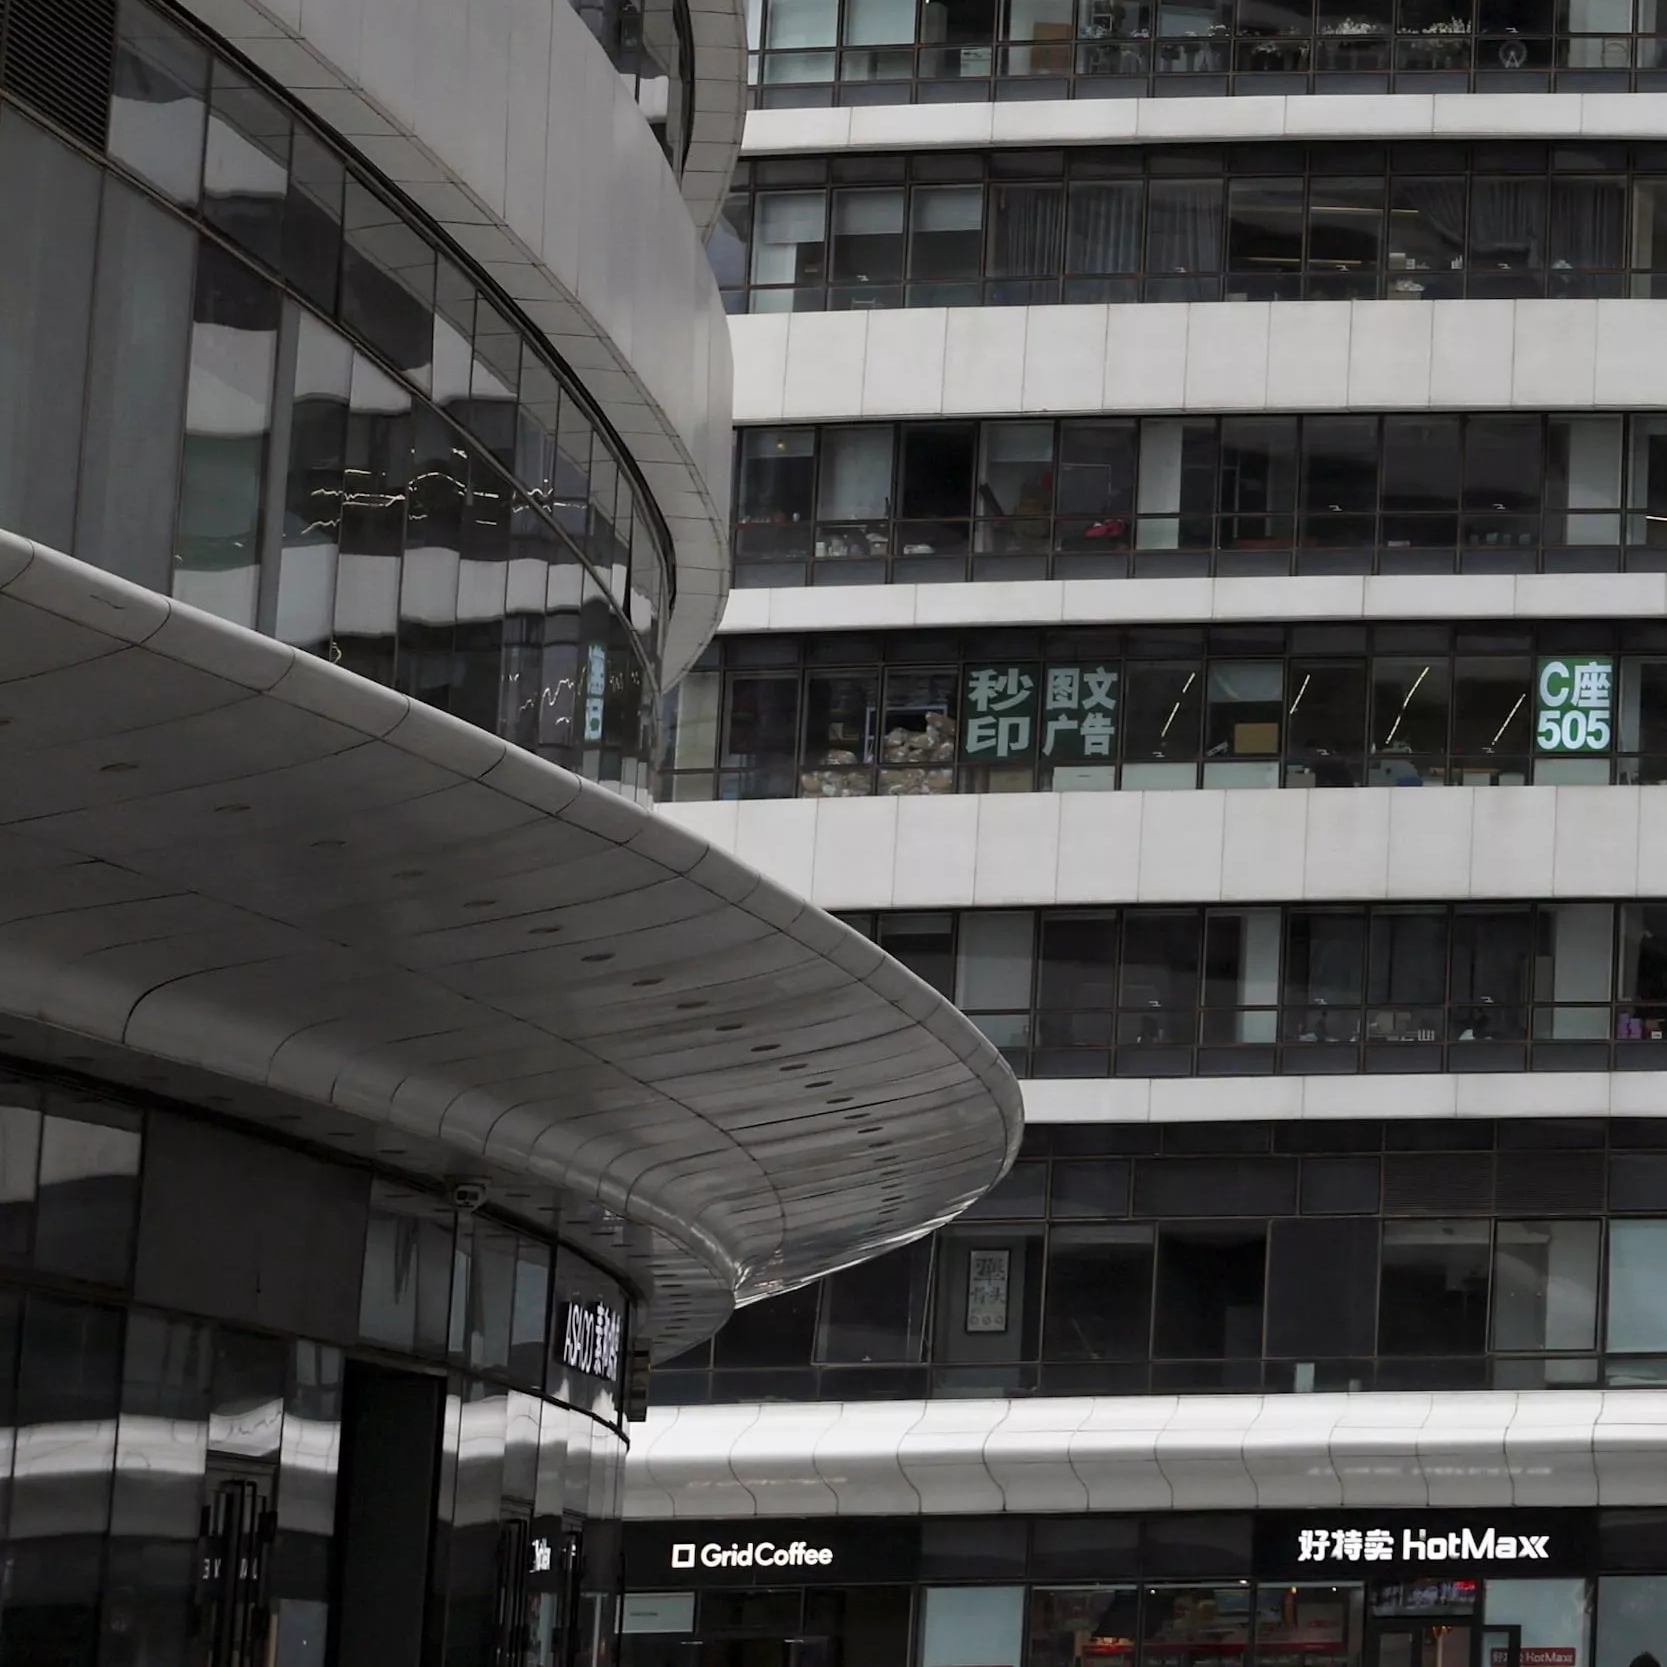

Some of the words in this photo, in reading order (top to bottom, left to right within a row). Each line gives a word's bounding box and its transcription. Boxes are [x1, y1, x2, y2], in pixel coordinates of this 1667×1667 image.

[1046, 666, 1118, 710] 图文
[1540, 661, 1612, 707] C座
[1042, 712, 1115, 756] 广告
[1537, 710, 1610, 750] 505
[1298, 1529, 1395, 1562] 好特卖
